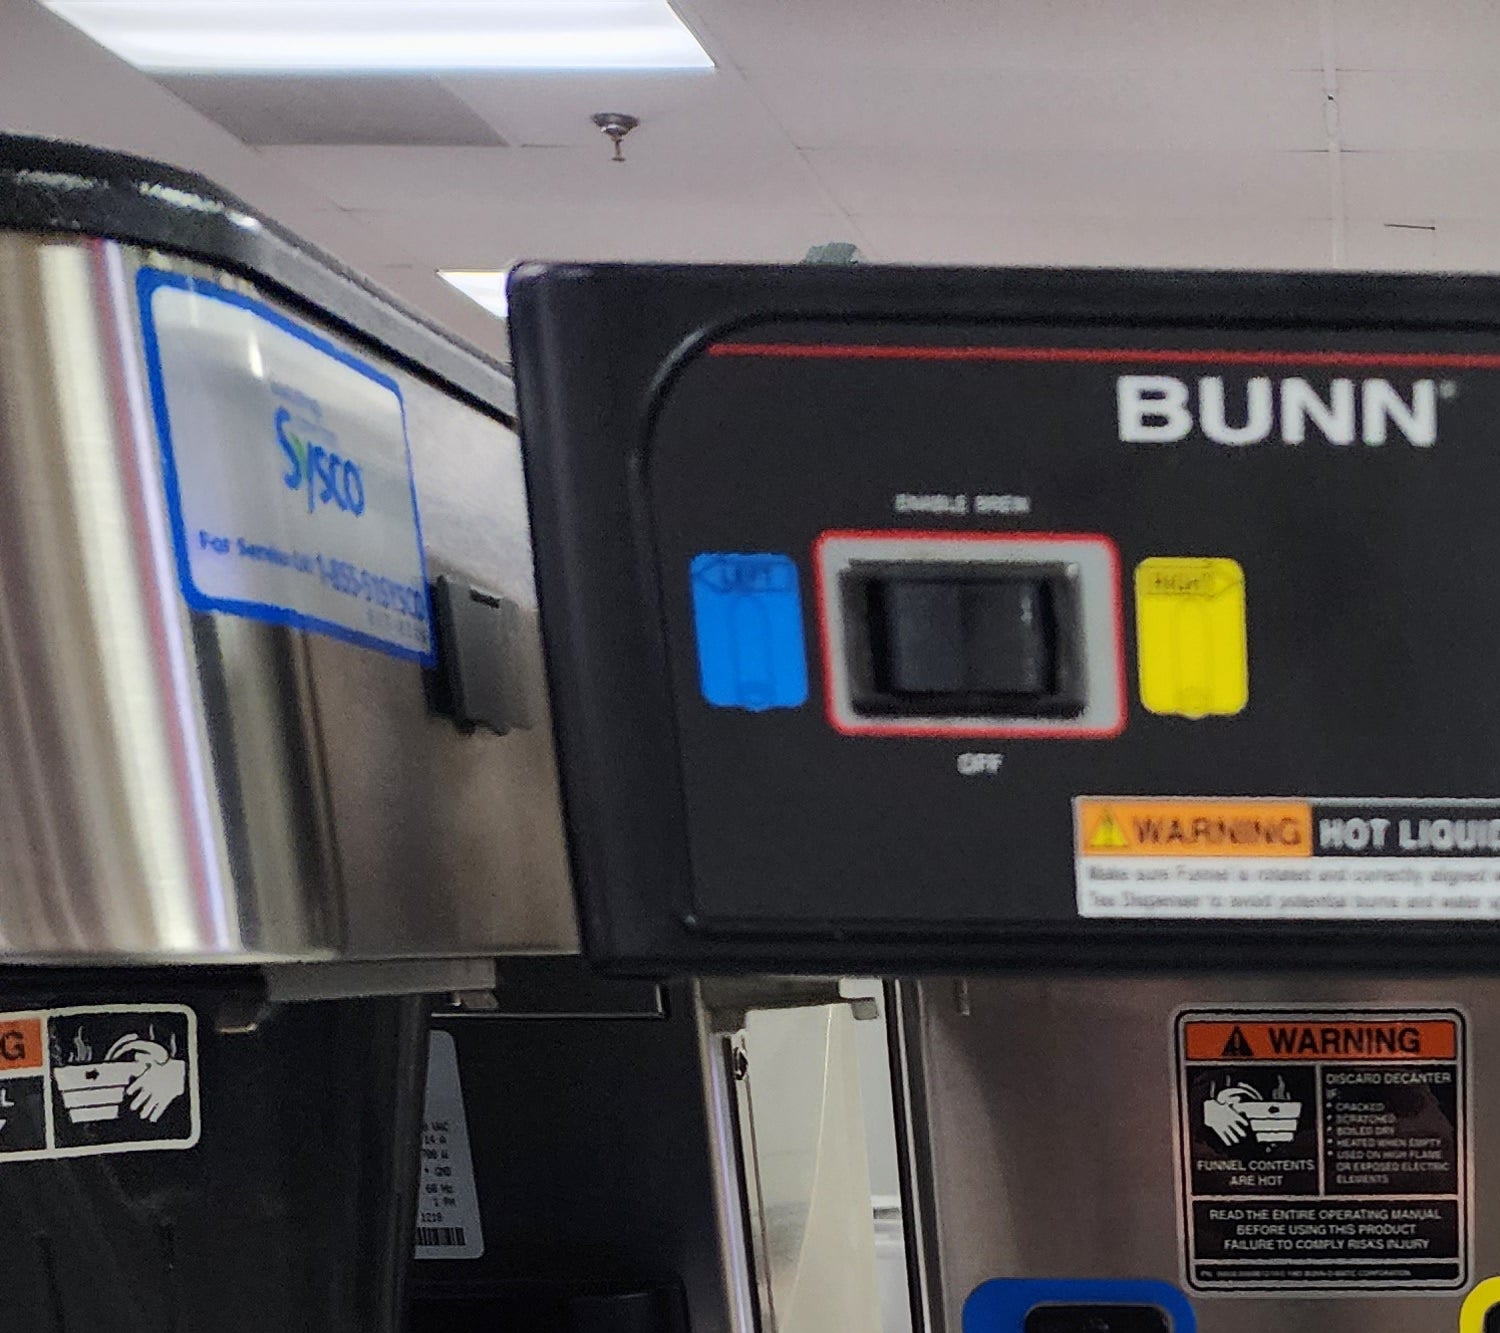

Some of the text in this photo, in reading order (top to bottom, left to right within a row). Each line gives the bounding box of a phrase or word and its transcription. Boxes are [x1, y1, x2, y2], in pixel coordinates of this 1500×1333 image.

[1116, 374, 1438, 448] BUNN
[274, 406, 365, 518] Sysco
[1131, 816, 1301, 845] WARNING
[1319, 818, 1390, 851] HOT
[1268, 1028, 1420, 1054] WARNING
[1326, 1073, 1451, 1084] DISCARD DECANTER
[1198, 1160, 1315, 1170] FUNNEL CONTENTS
[1229, 1176, 1283, 1185] ARE HOT
